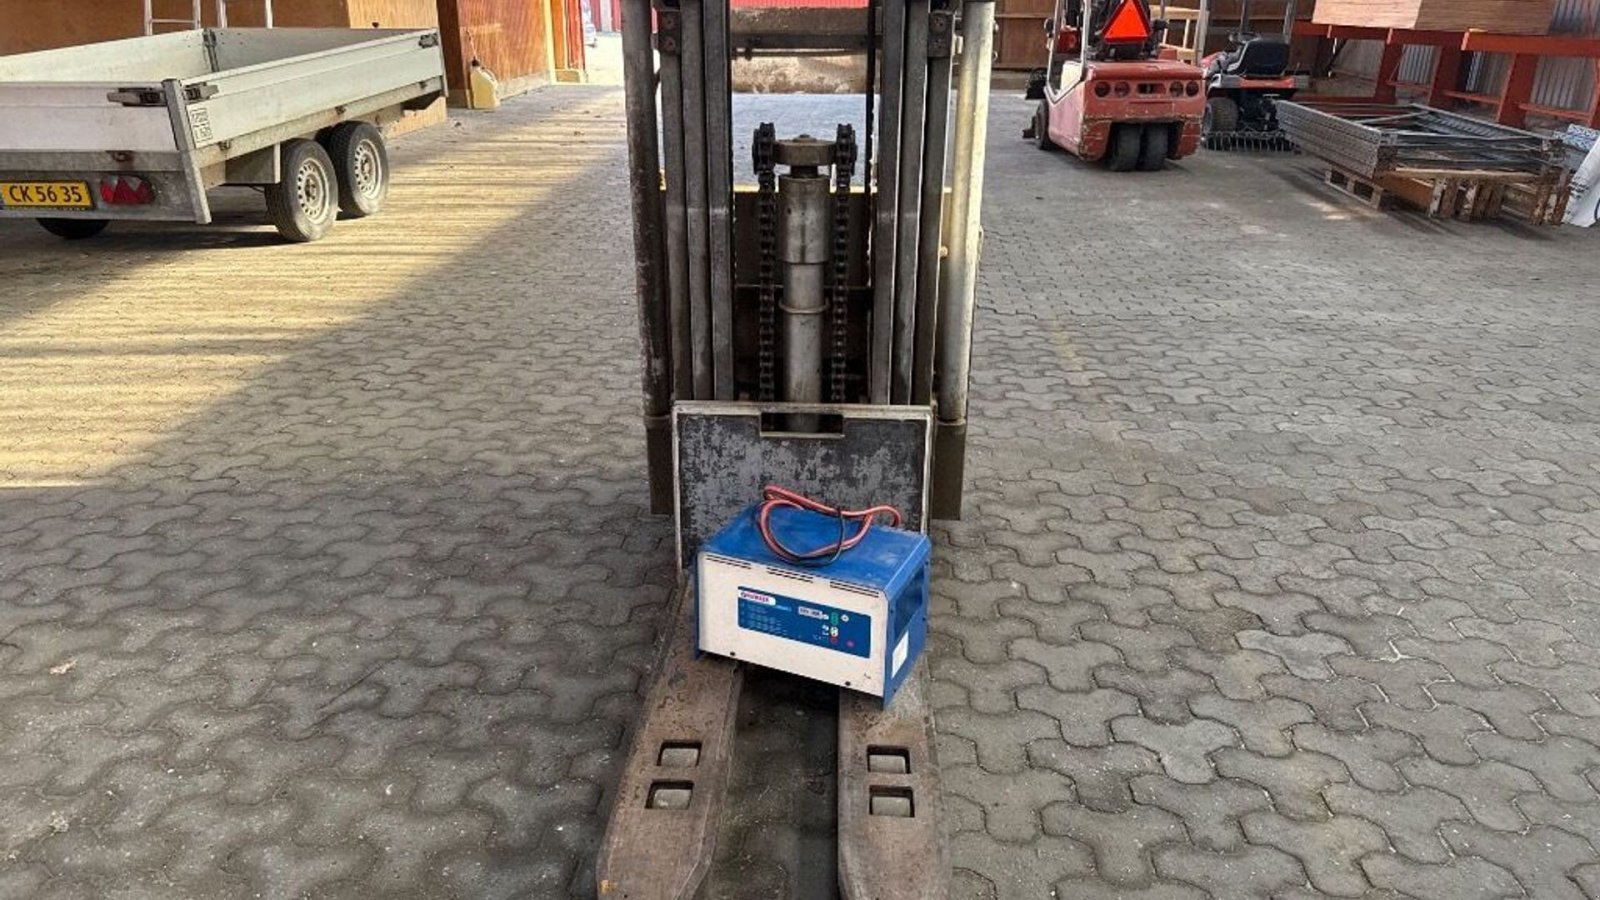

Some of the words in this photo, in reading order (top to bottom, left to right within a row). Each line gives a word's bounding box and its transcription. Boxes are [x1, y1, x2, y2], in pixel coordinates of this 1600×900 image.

[9, 185, 34, 203] CK
[35, 185, 58, 203] 56
[59, 185, 83, 203] 35
